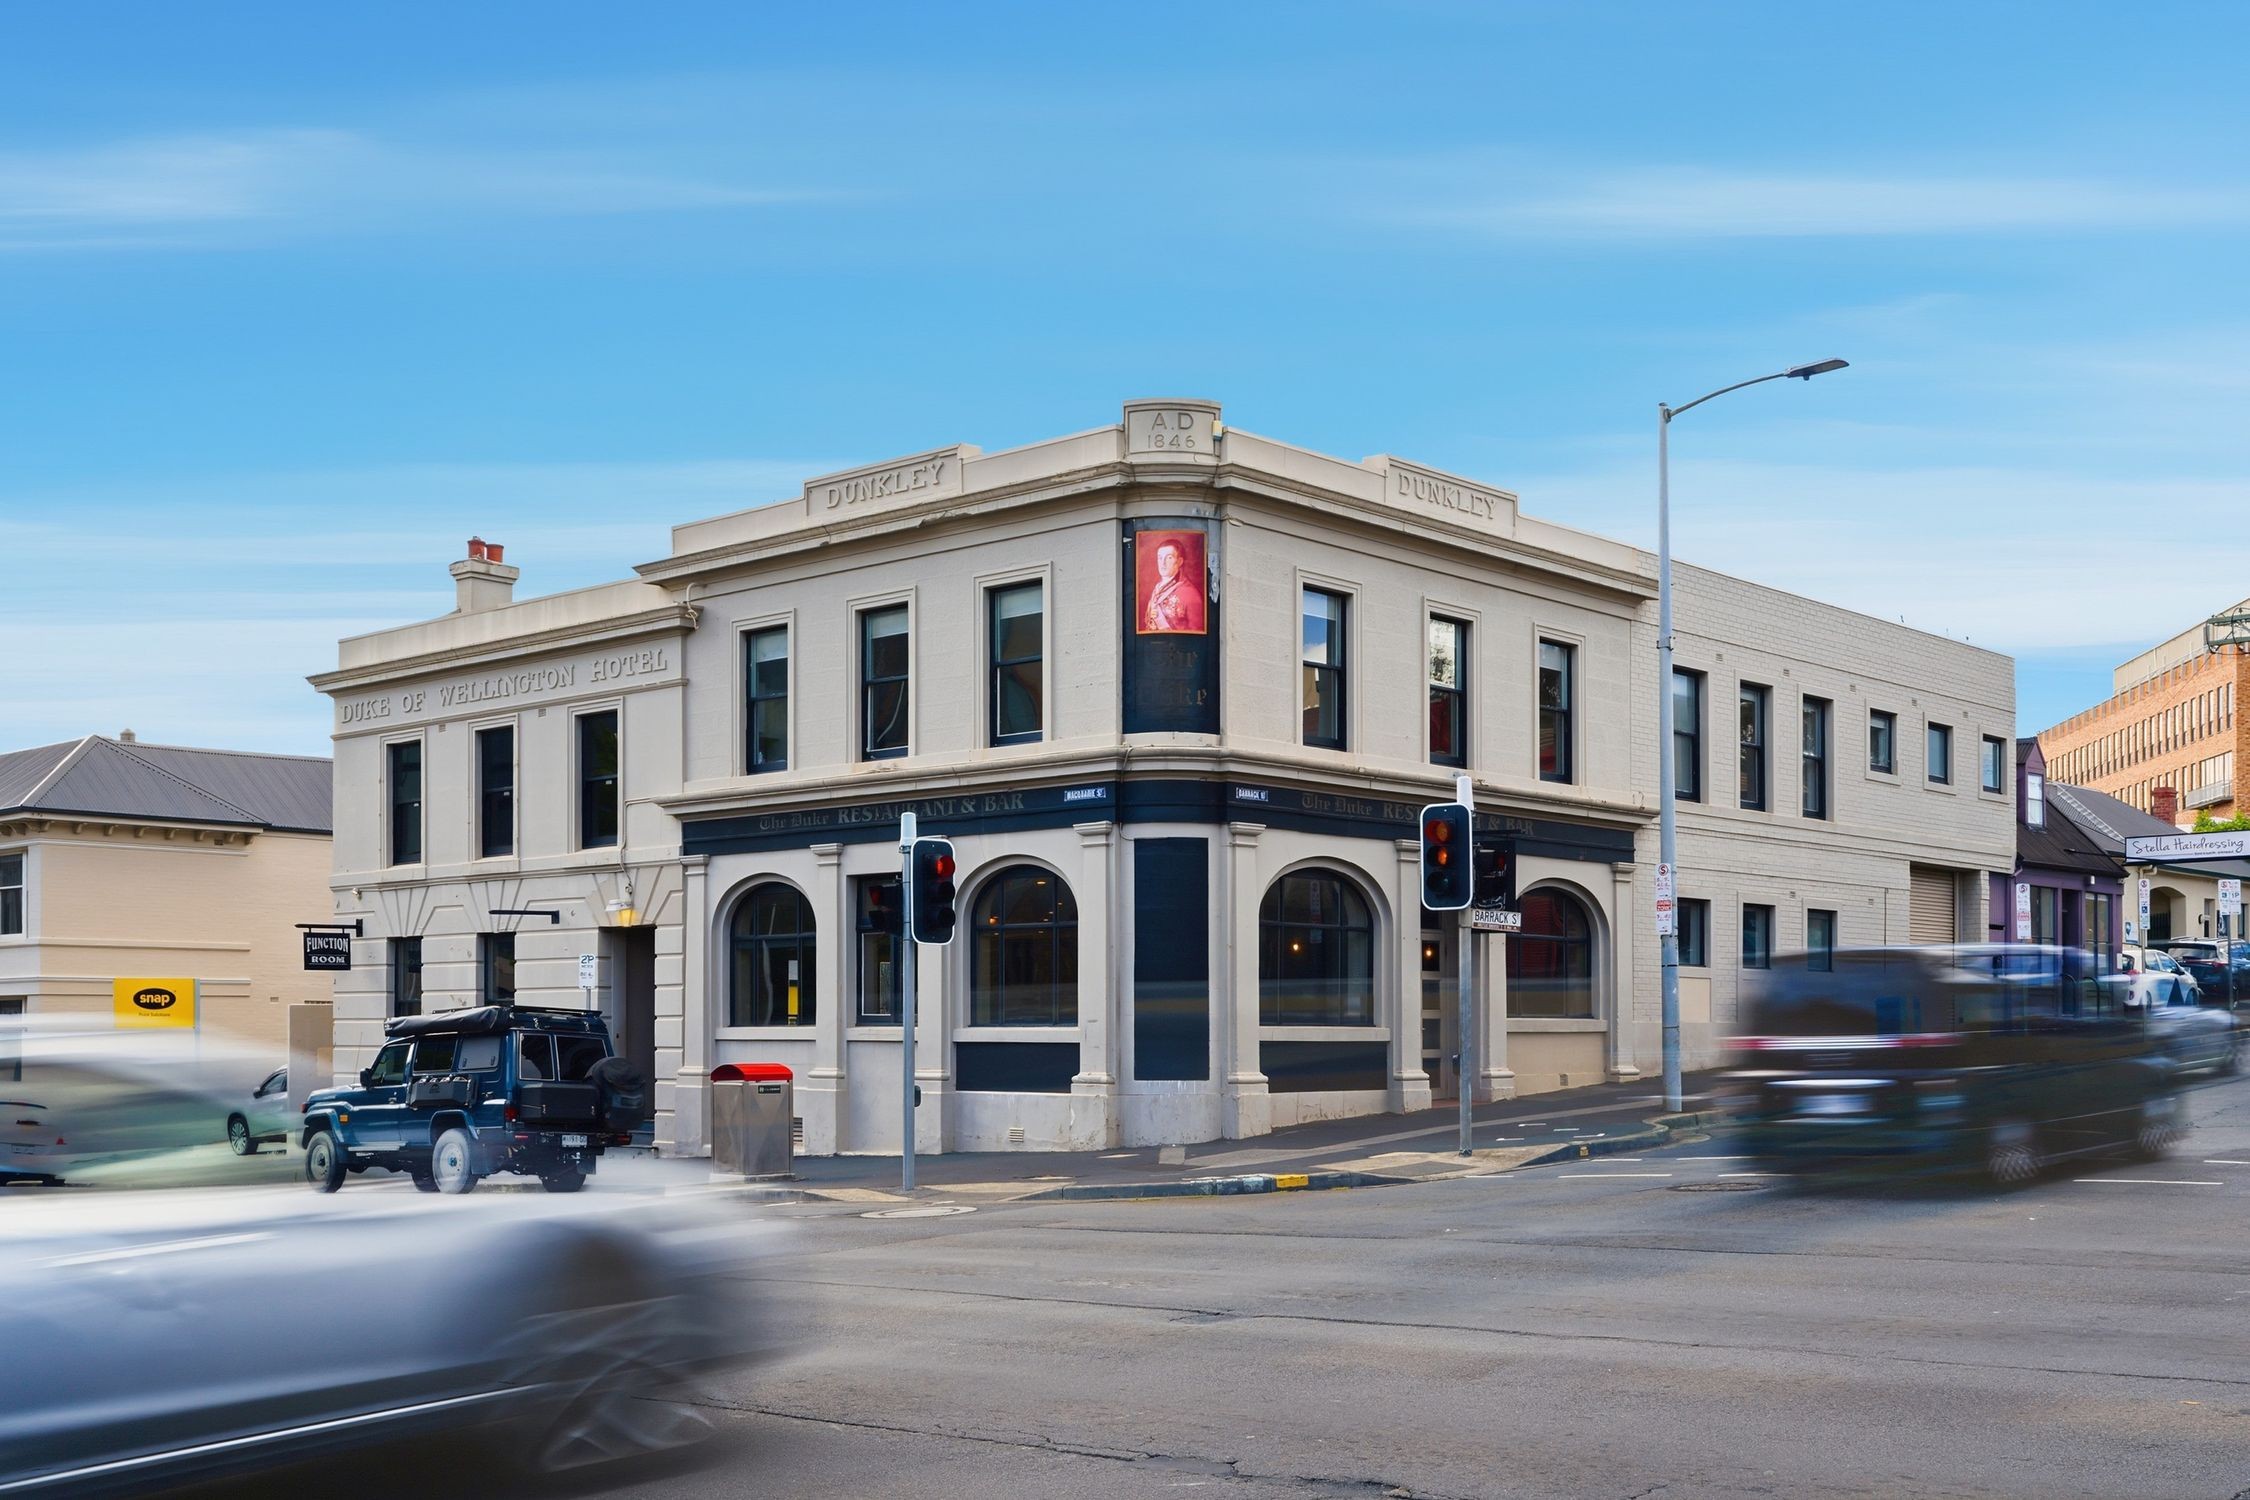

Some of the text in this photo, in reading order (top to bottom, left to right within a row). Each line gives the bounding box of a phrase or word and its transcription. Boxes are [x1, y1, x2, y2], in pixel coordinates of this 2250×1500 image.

[1147, 433, 1196, 449] 1846
[826, 461, 945, 509] DUNKLEY
[1398, 472, 1496, 520] DUNKLEY
[341, 648, 668, 724] DUKE OF WELLINGTON HOTEL
[960, 797, 976, 814] &
[984, 792, 1025, 812] BAR
[2132, 836, 2245, 855] Stella Hairdressing
[1474, 910, 1509, 924] BARRACK
[306, 937, 349, 953] FUNCTION
[311, 955, 345, 964] ROOM
[580, 954, 595, 965] 2P
[139, 993, 171, 1007] snap
